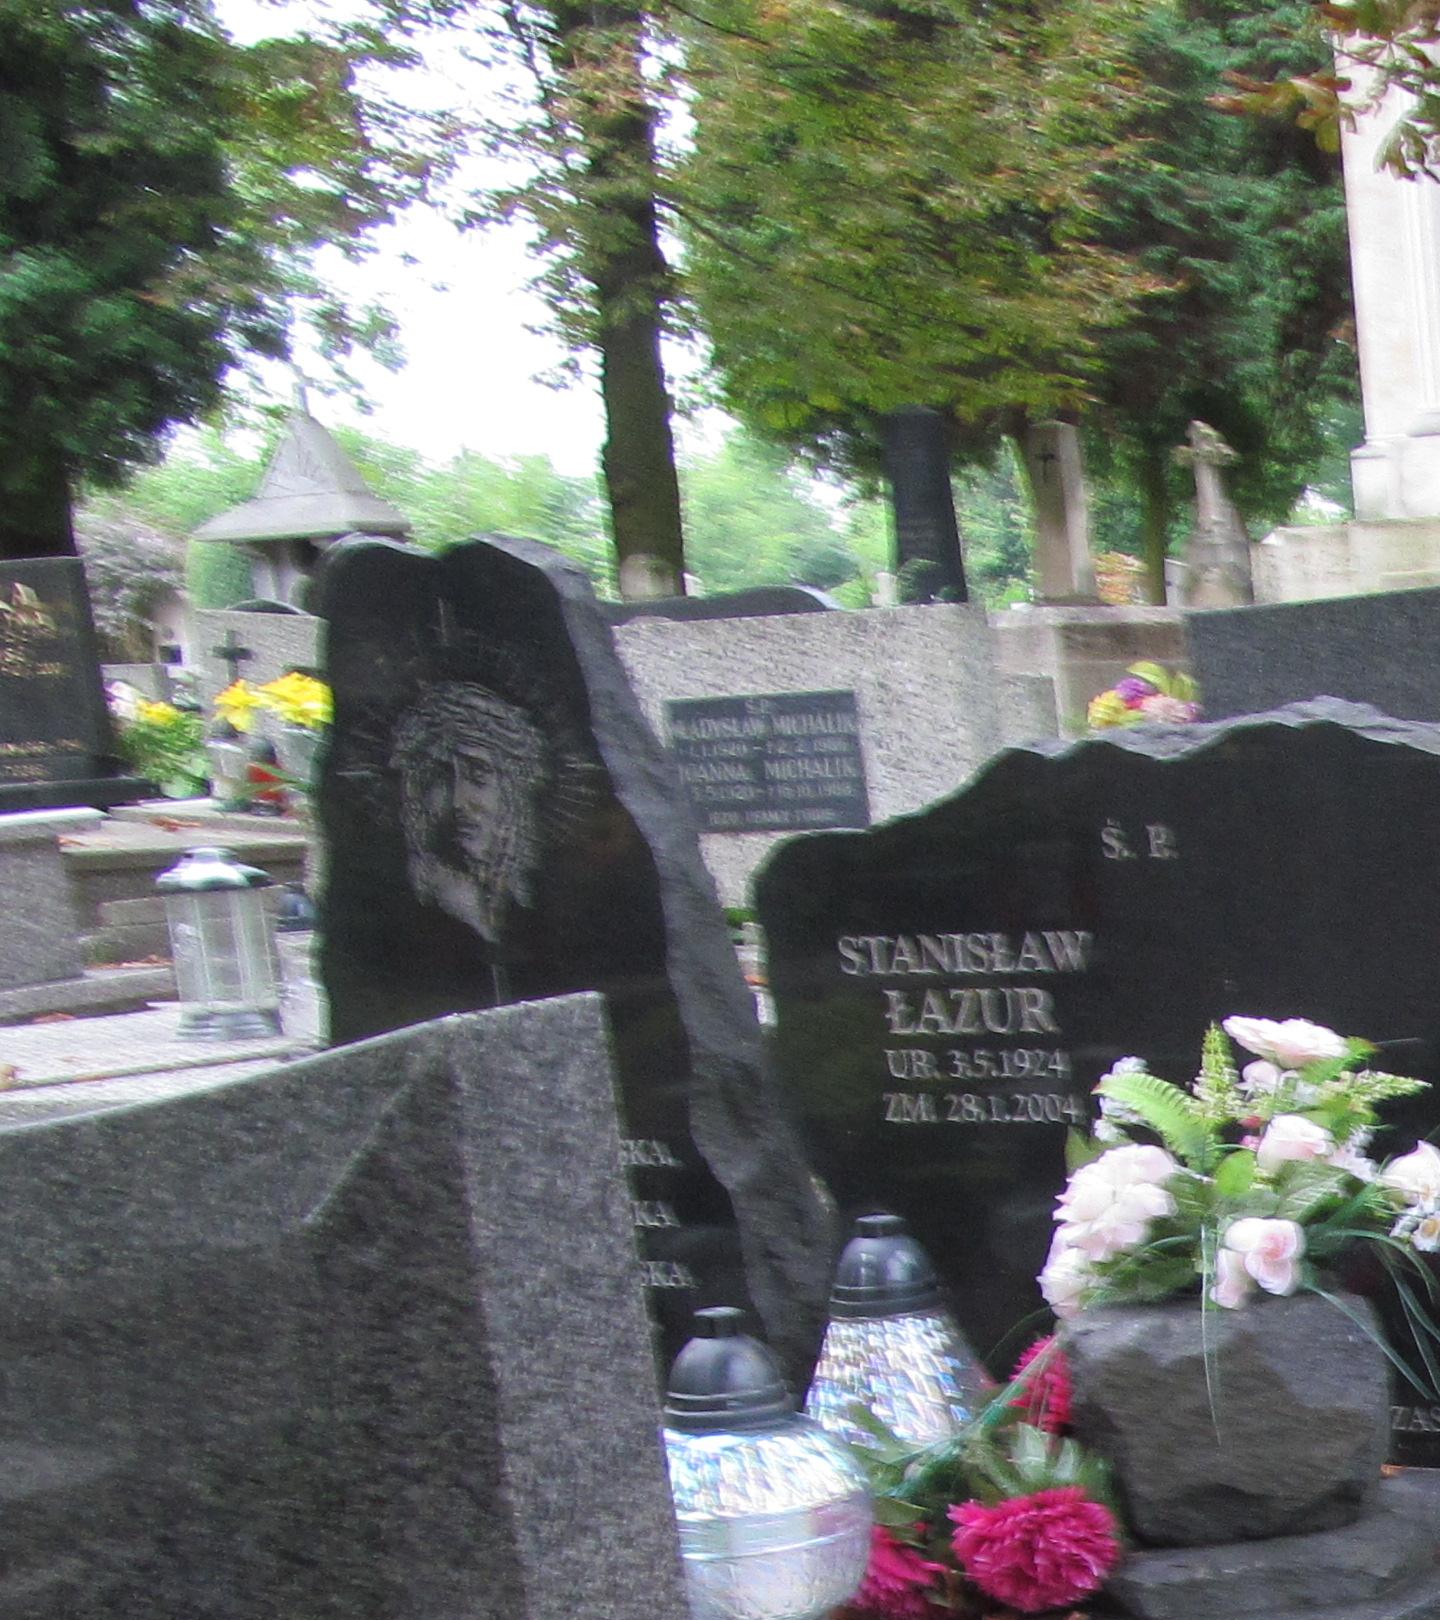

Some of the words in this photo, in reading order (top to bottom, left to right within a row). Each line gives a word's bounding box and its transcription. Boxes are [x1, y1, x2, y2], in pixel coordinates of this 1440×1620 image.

[764, 756, 858, 780] MICHALIK
[837, 930, 1095, 977] STANISŁAW
[884, 987, 1060, 1036] ŁAZUR
[885, 1049, 938, 1081] UR.
[949, 1047, 1072, 1080] 3.5.1924
[883, 1092, 938, 1123] ZM.
